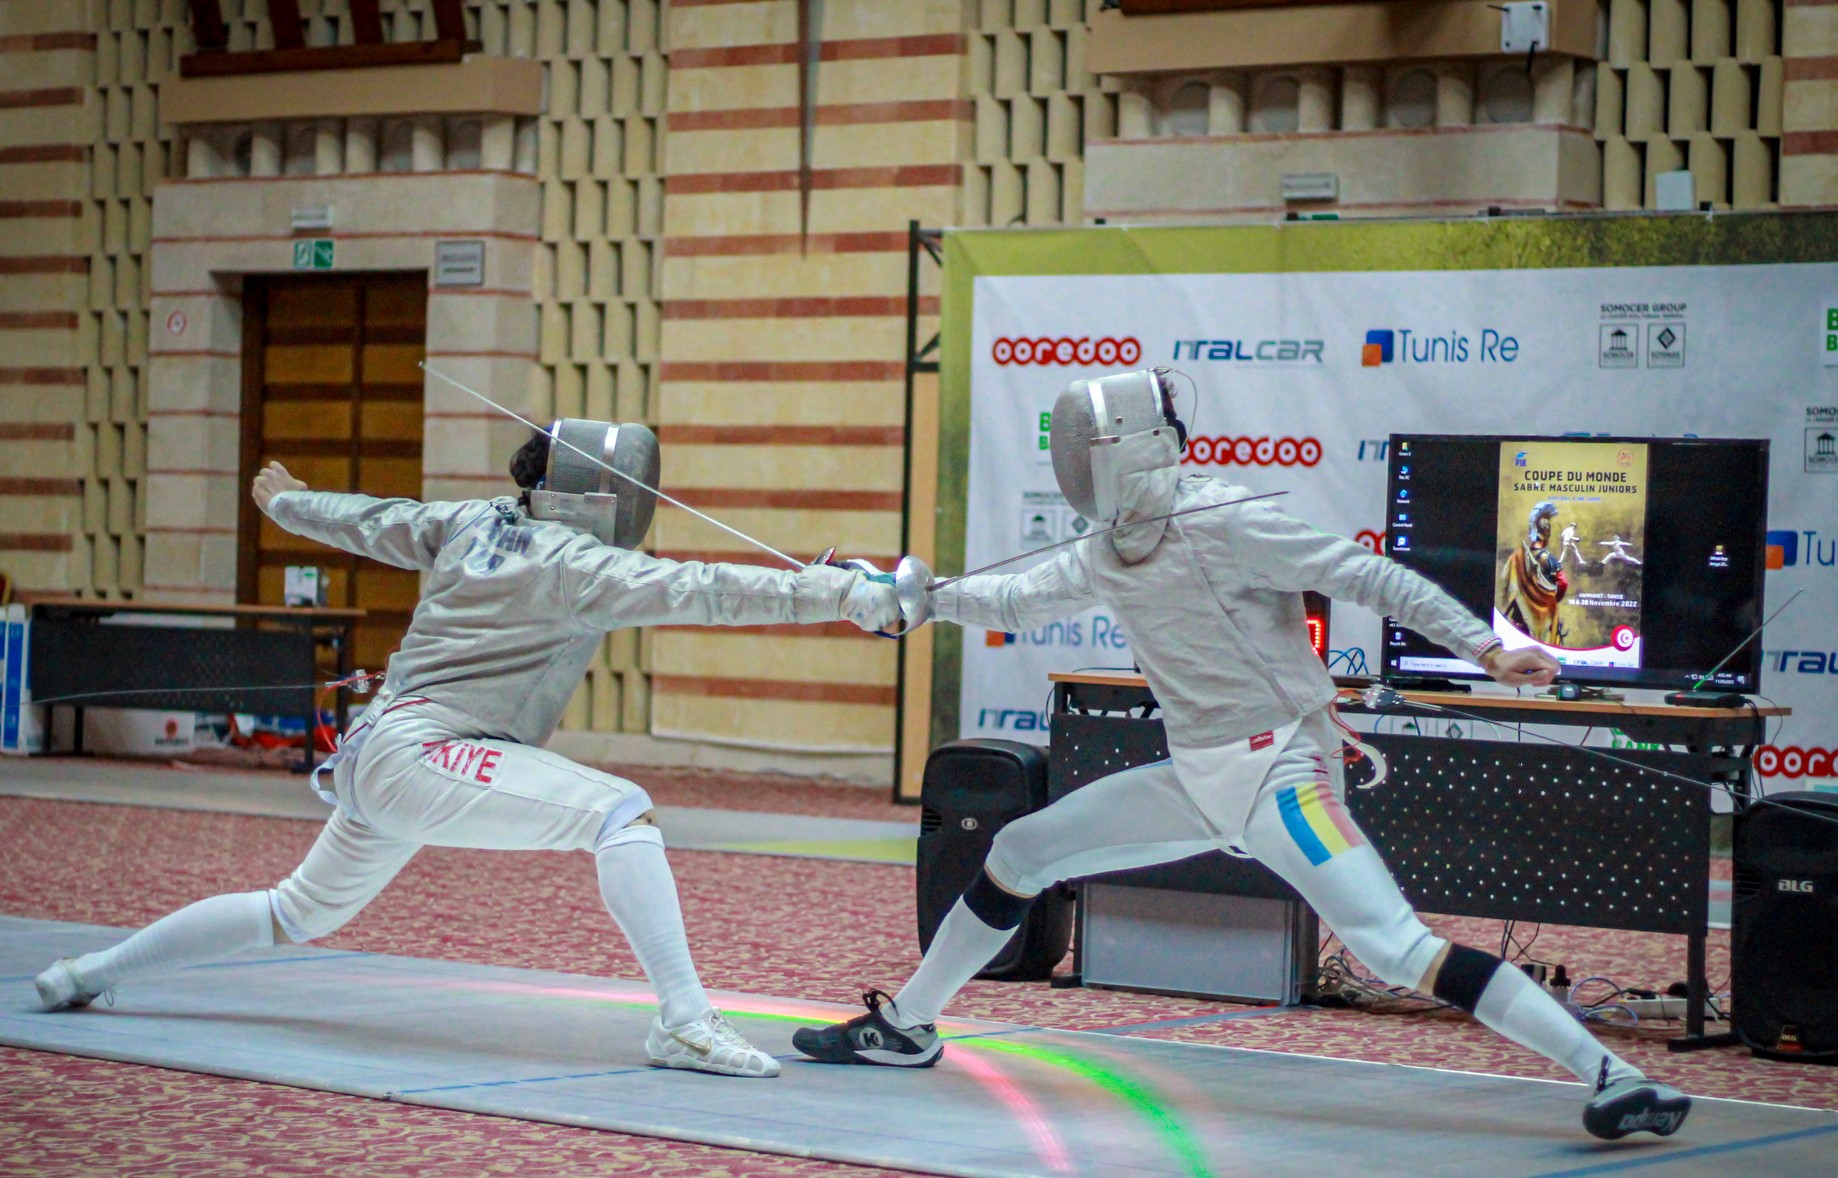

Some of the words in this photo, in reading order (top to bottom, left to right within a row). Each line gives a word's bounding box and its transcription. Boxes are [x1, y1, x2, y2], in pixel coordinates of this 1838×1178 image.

[1652, 302, 1688, 312] GROUP
[992, 336, 1142, 366] ooredoo
[1398, 329, 1469, 363] Tunis
[1481, 328, 1519, 363] Re
[1515, 458, 1527, 467] FIE
[1524, 470, 1563, 481] COUPE
[1567, 471, 1582, 482] DU
[1586, 472, 1627, 483] MONDE
[1513, 482, 1546, 492] SABRE
[1549, 483, 1595, 493] MASCULIN
[1598, 484, 1637, 494] JUNIORS
[1590, 599, 1620, 607] Novembre
[1621, 600, 1638, 608] 2022
[1753, 745, 1838, 778] oor
[1778, 879, 1814, 893] BLG
